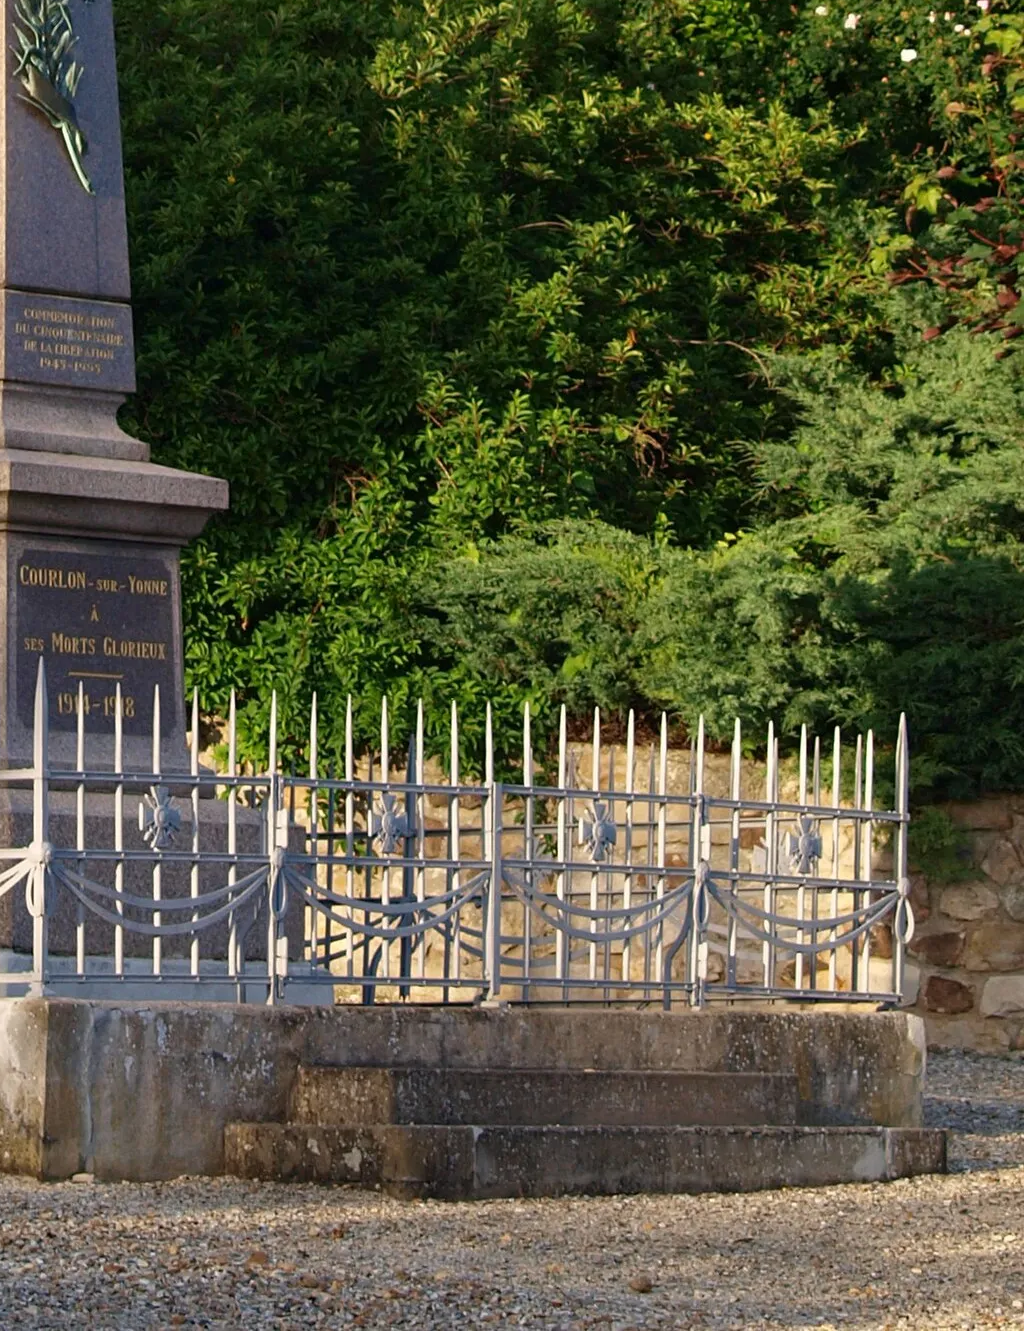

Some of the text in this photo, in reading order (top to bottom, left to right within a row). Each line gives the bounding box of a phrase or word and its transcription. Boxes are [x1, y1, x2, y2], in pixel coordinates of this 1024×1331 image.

[15, 322, 30, 334] DU
[24, 339, 37, 352] DE
[40, 341, 52, 354] LA
[23, 632, 166, 660] SES MORTS GLORIEUX
